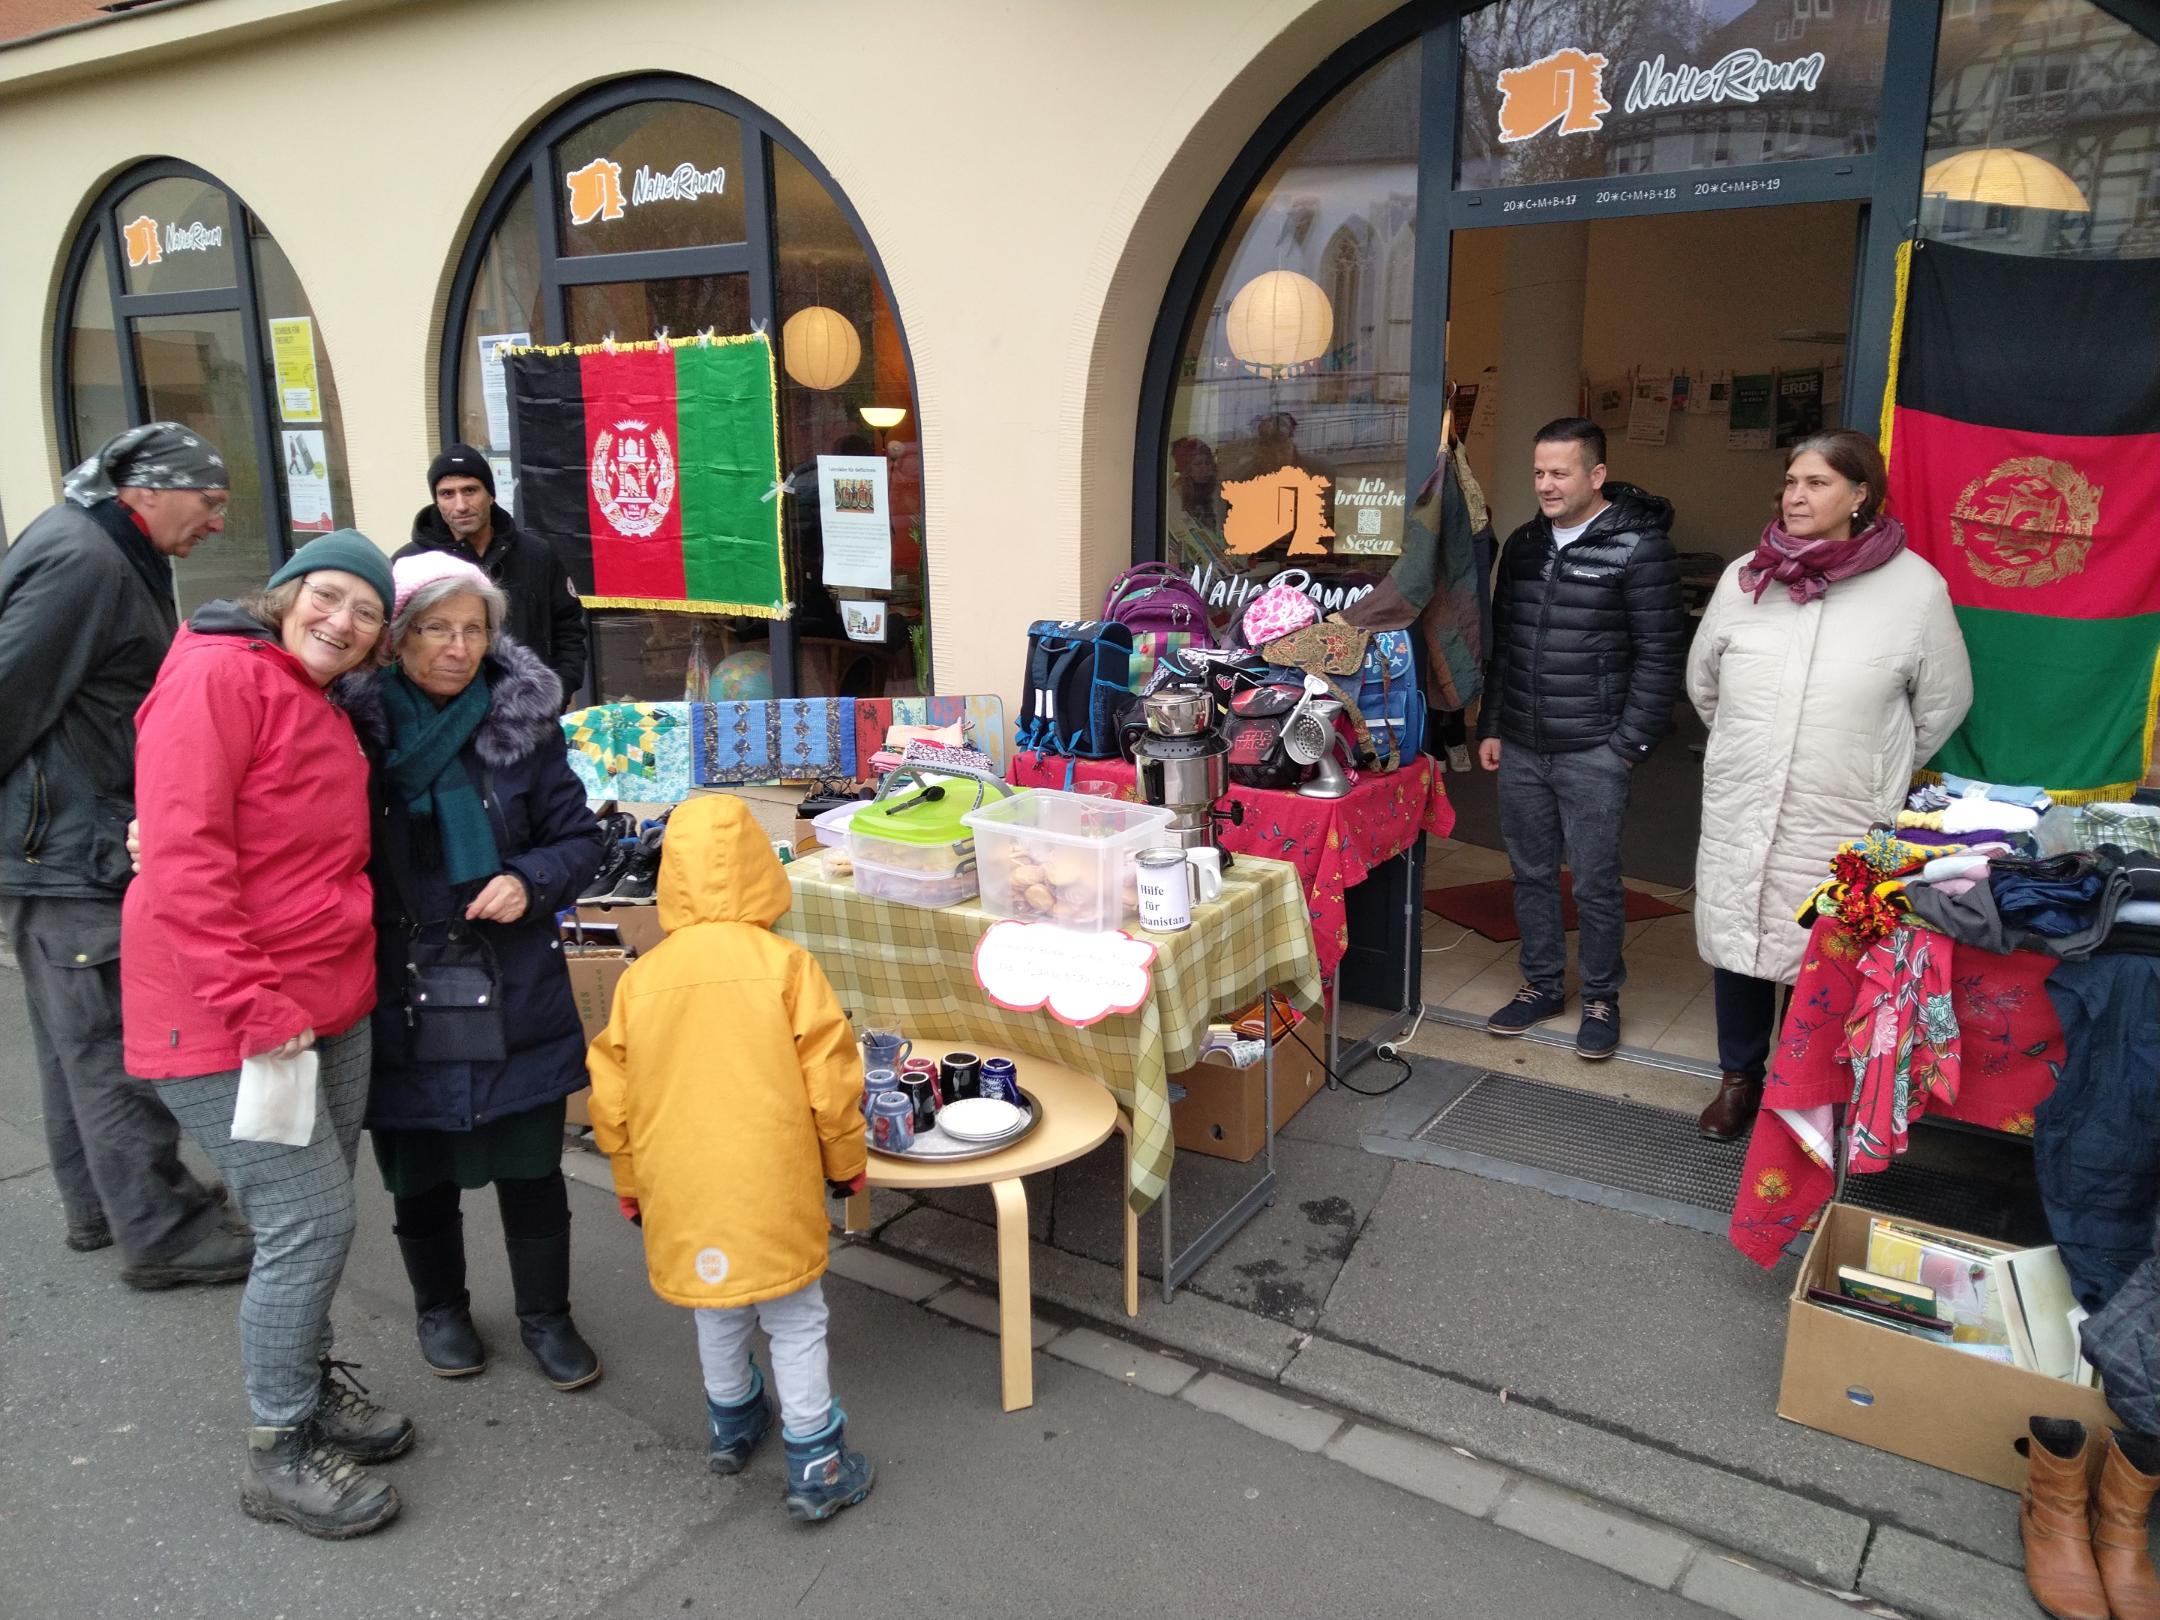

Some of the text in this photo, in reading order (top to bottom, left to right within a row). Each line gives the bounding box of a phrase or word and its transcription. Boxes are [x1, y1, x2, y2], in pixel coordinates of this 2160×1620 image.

[1780, 380, 1819, 396] ERDE
[1358, 478, 1386, 493] Ich
[1335, 490, 1405, 506] brauche
[1342, 534, 1394, 554] Segen
[1236, 730, 1273, 741] STAR
[1235, 739, 1273, 750] WARS
[1140, 884, 1164, 896] Hilfe
[1145, 900, 1160, 911] für
